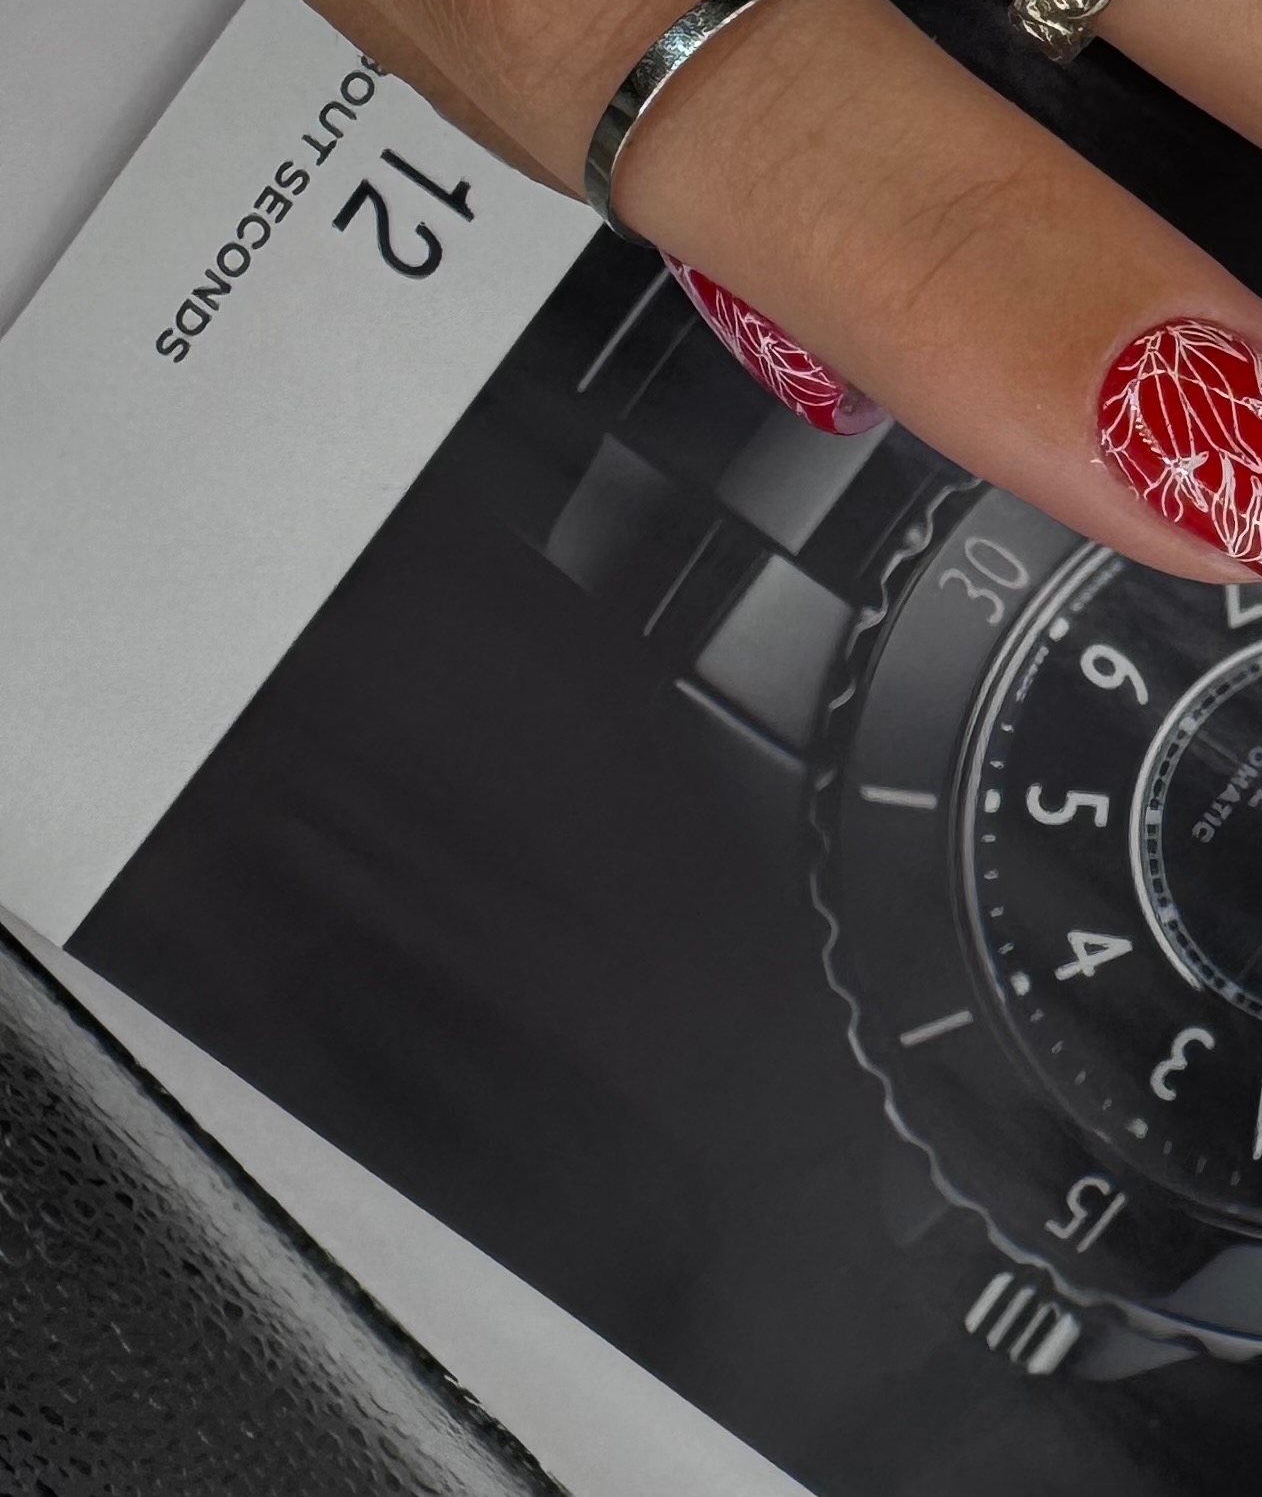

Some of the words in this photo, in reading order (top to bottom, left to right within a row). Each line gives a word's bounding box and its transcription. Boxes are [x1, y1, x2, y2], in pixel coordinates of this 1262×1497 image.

[155, 160, 311, 363] SECONDS
[938, 536, 1029, 625] 30
[1079, 642, 1149, 706] 6
[1025, 782, 1111, 828] 5
[1054, 929, 1134, 981] 4
[1149, 1026, 1216, 1102] 3
[1044, 1174, 1127, 1254] 15
